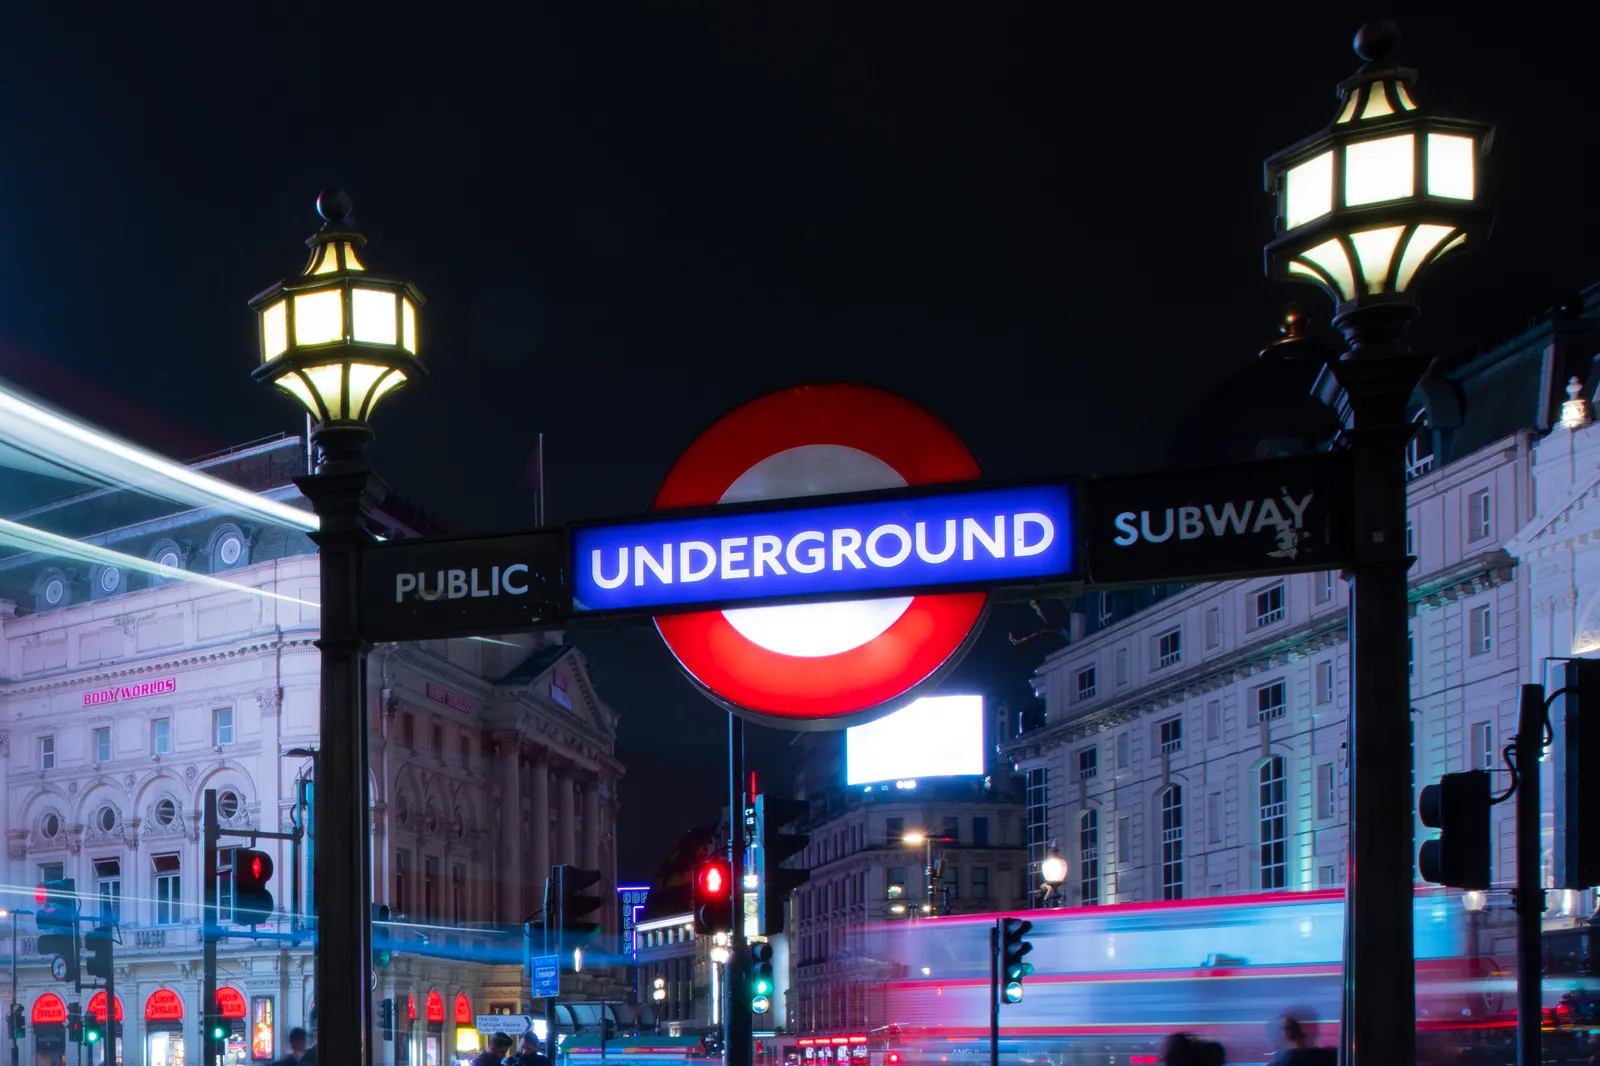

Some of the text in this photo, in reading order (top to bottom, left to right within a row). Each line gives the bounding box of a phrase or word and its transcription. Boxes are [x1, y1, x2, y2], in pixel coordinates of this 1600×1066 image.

[1113, 486, 1314, 546] SUBWAY
[591, 512, 1055, 589] UNDERGROUND
[395, 563, 529, 603] PUBLIC
[82, 678, 177, 707] BODY WORLDS
